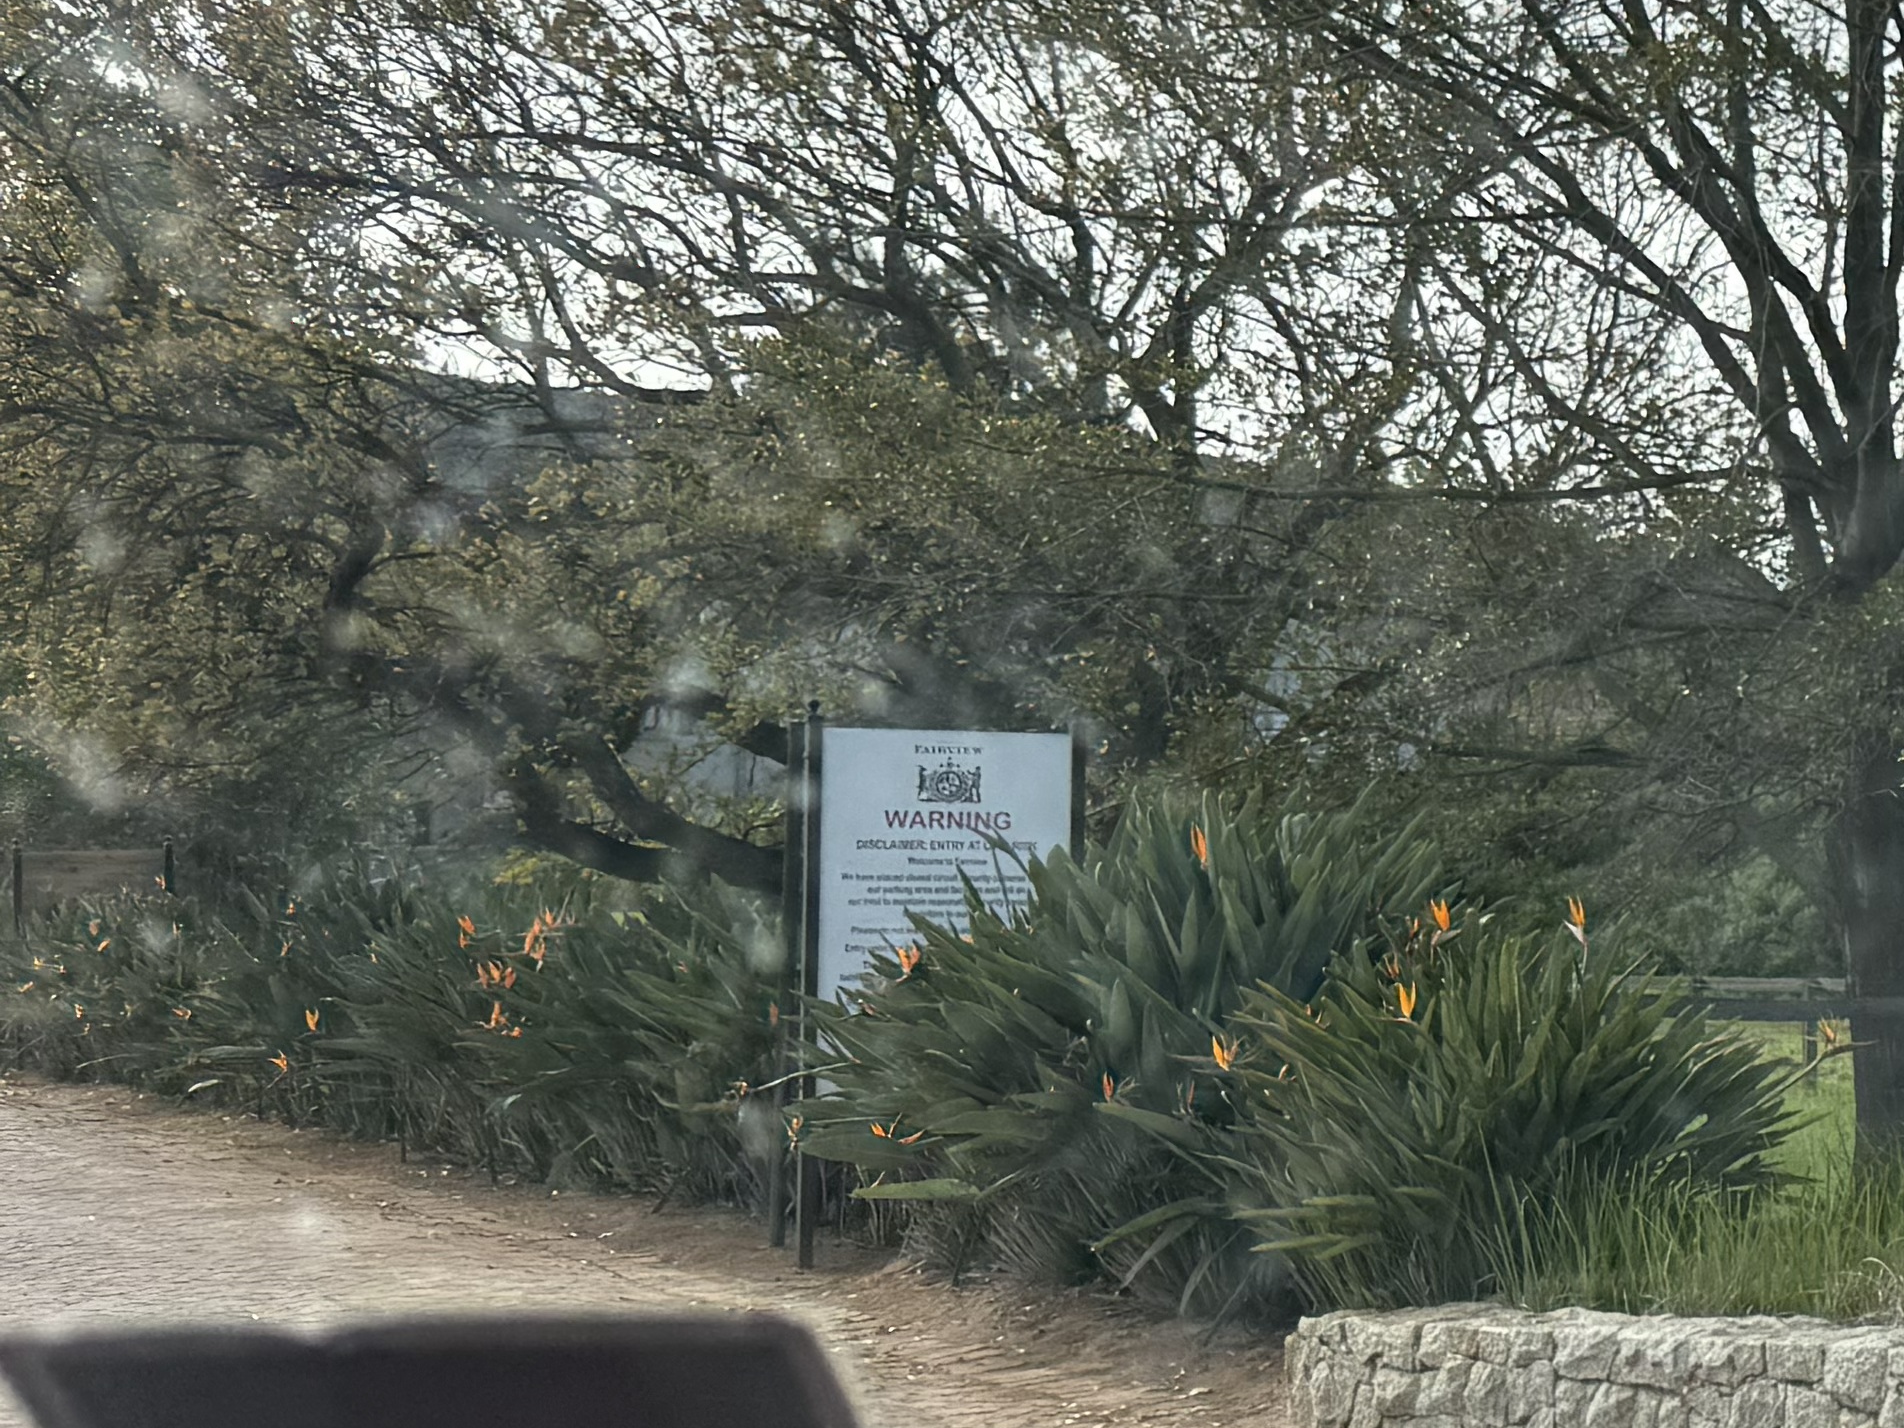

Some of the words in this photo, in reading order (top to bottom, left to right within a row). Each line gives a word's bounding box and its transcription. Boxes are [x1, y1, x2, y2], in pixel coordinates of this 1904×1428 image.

[914, 743, 984, 754] FAIRVIEW
[884, 809, 1011, 830] WARNING
[930, 840, 964, 850] ENTRY
